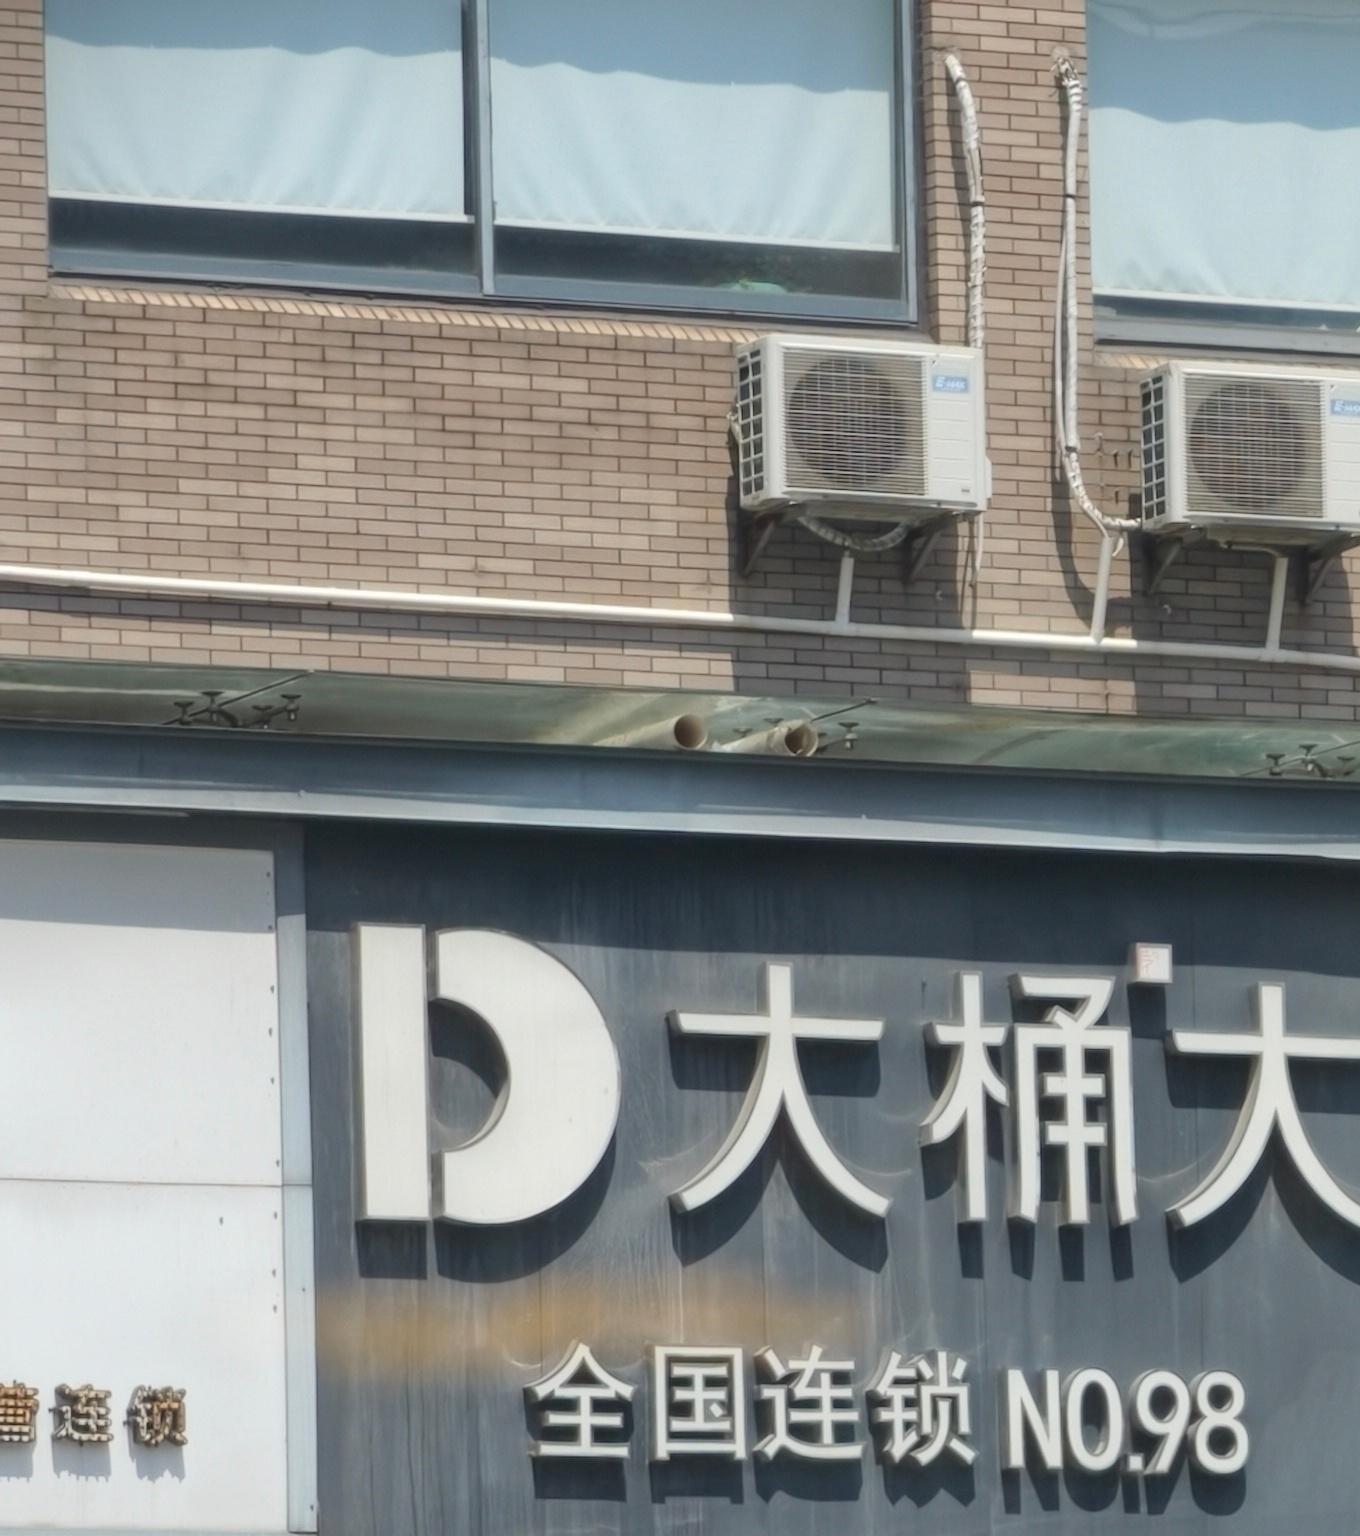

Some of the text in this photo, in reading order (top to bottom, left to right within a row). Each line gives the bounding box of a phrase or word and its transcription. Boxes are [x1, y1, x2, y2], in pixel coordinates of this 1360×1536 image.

[525, 1340, 1250, 1477] 全国连锁 NO.98
